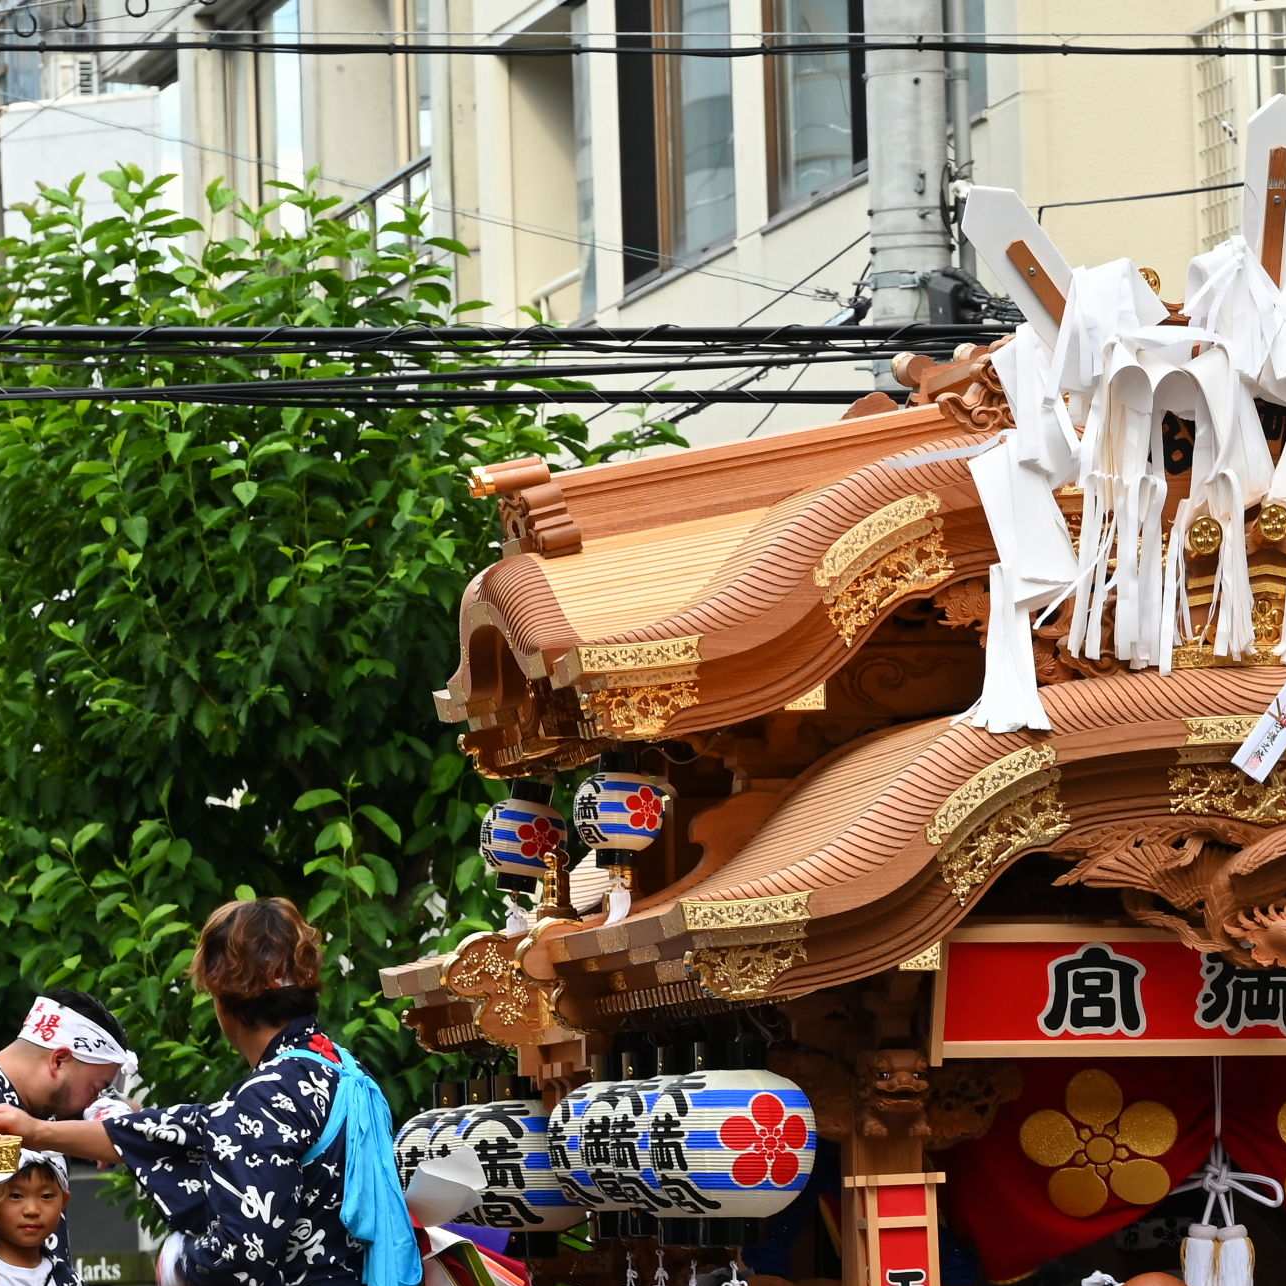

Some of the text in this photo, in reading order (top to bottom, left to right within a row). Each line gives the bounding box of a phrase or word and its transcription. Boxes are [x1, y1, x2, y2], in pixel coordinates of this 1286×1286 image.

[464, 1102, 544, 1229] 天満宮
[650, 1075, 721, 1213] 天満宮
